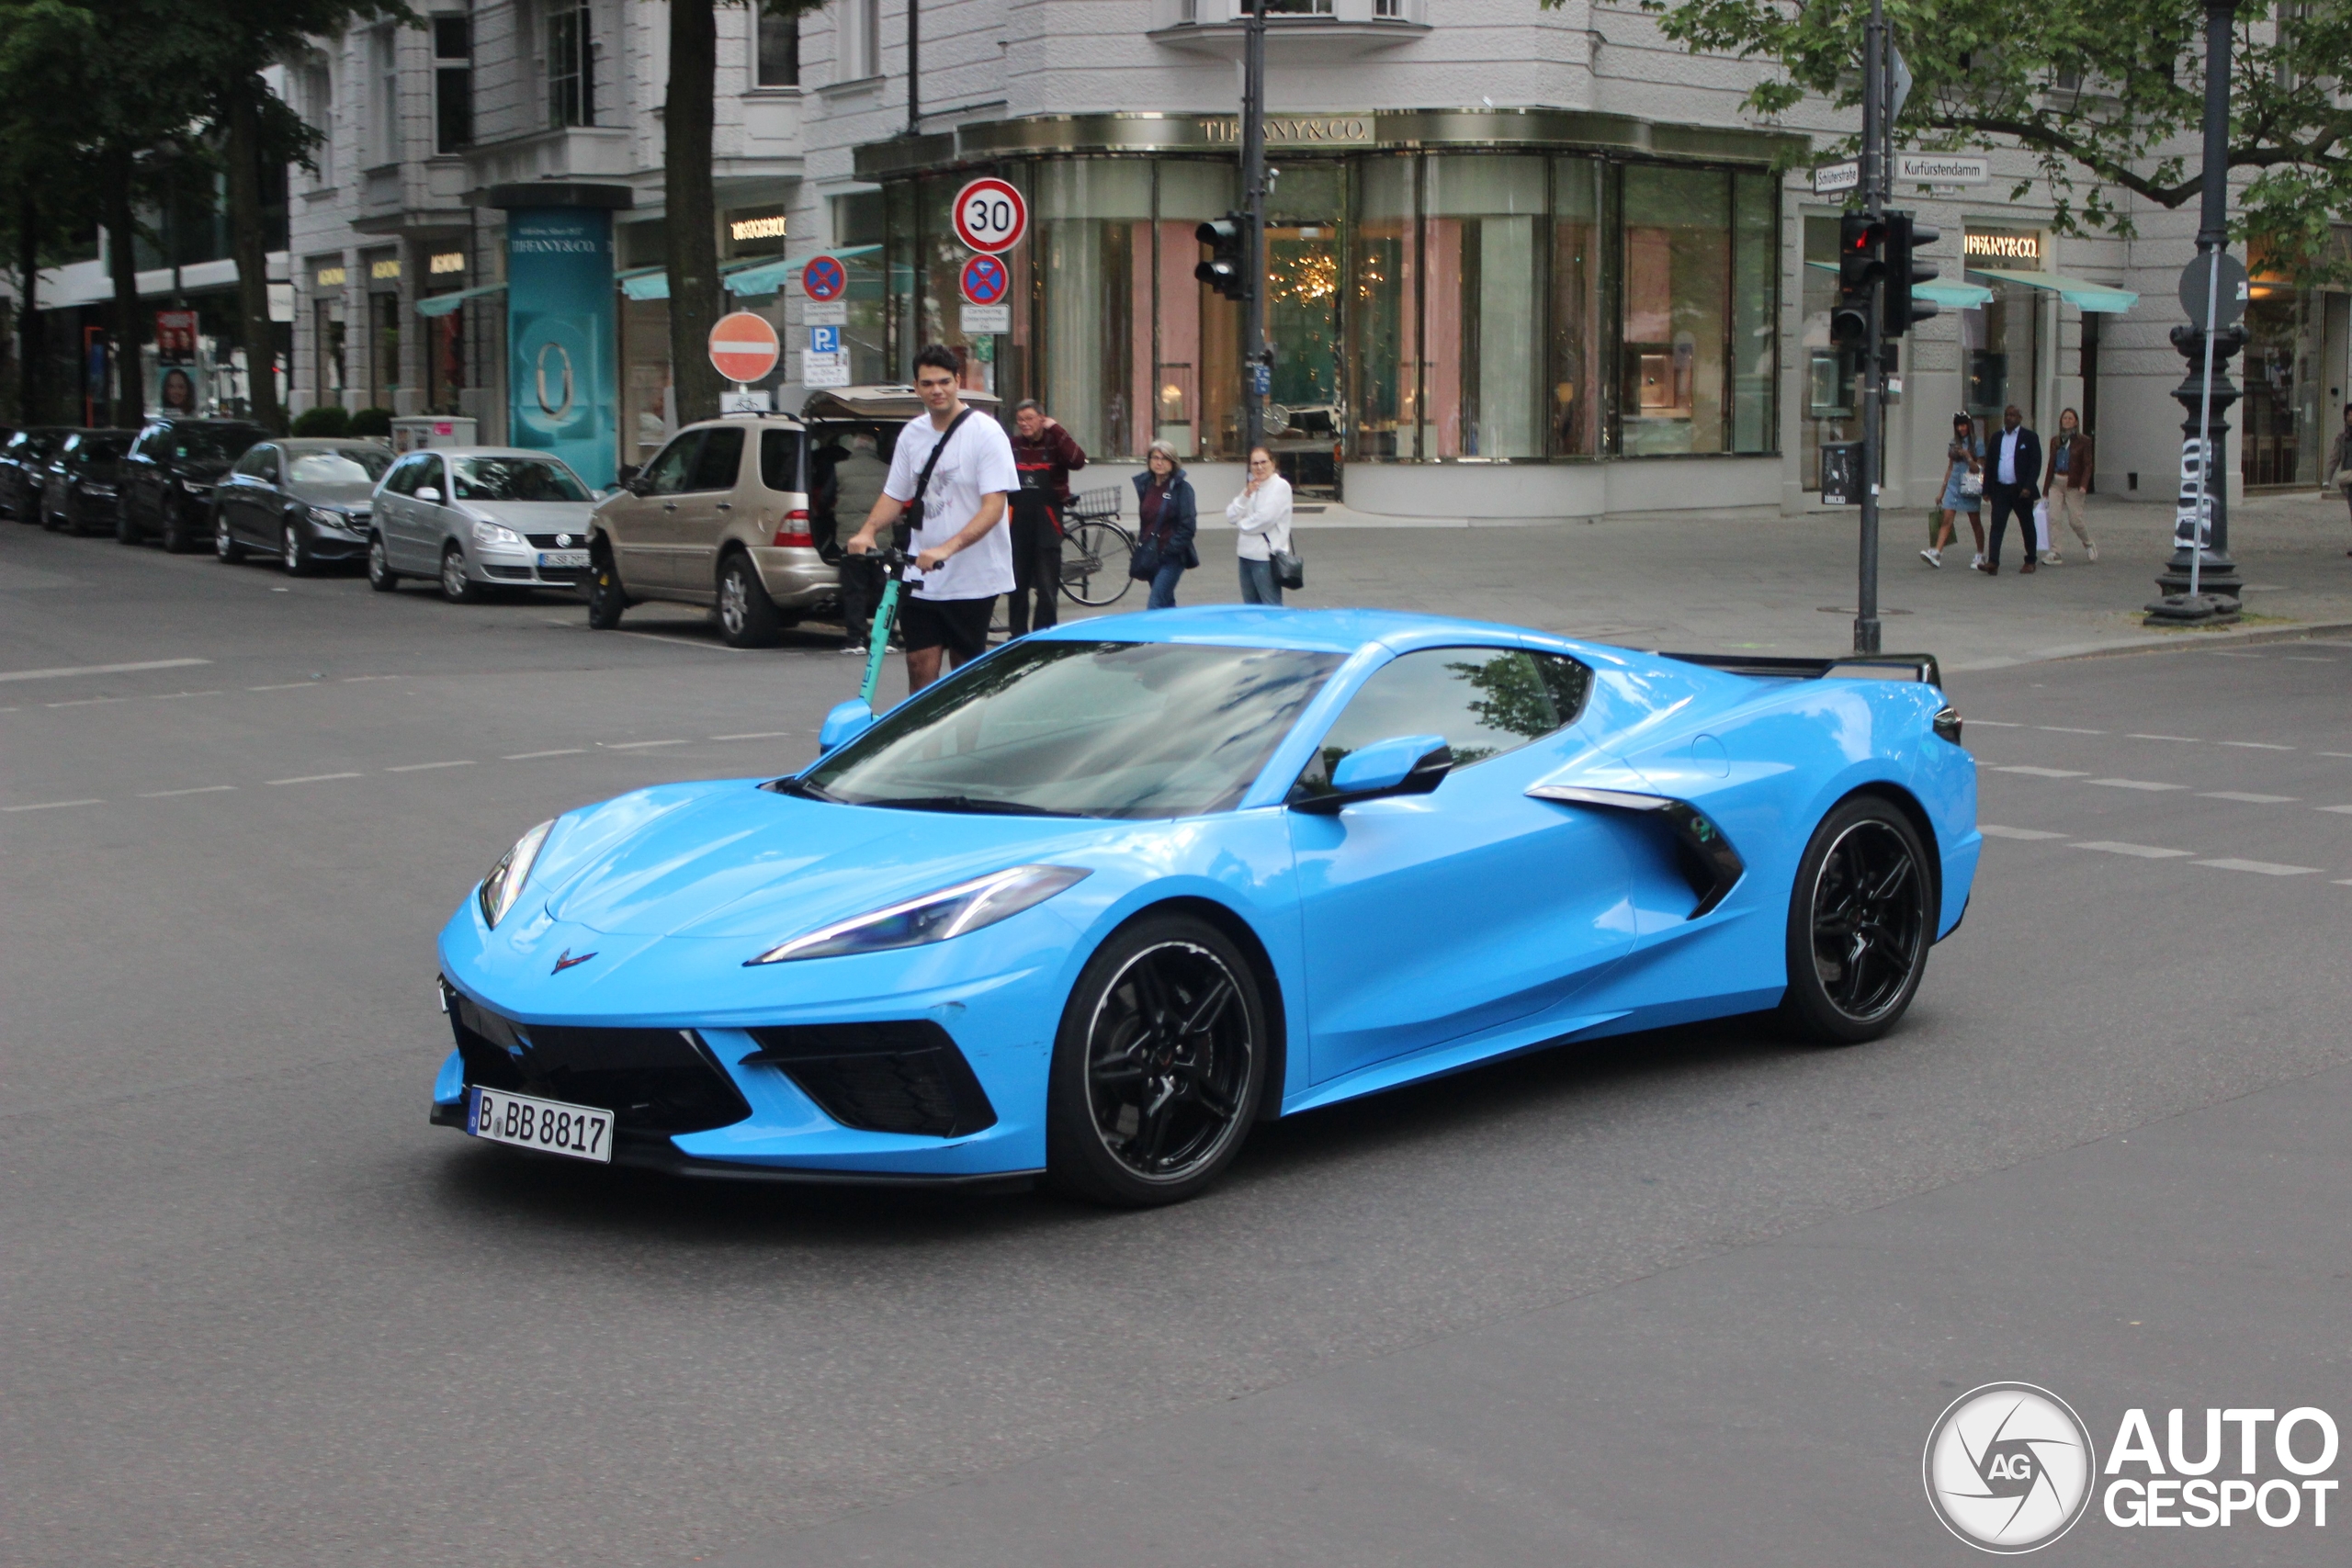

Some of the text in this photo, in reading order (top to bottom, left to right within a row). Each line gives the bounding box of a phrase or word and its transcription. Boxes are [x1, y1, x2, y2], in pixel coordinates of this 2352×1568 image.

[1199, 118, 1368, 142] TIFANY&CO.
[1817, 166, 1857, 186] Schlüterstraße
[1904, 160, 1981, 177] Kurfürstendamm
[970, 199, 1010, 231] 30
[1963, 234, 2040, 258] IFFANY&CO.
[814, 328, 831, 351] P
[479, 1096, 606, 1154] B BB 8817
